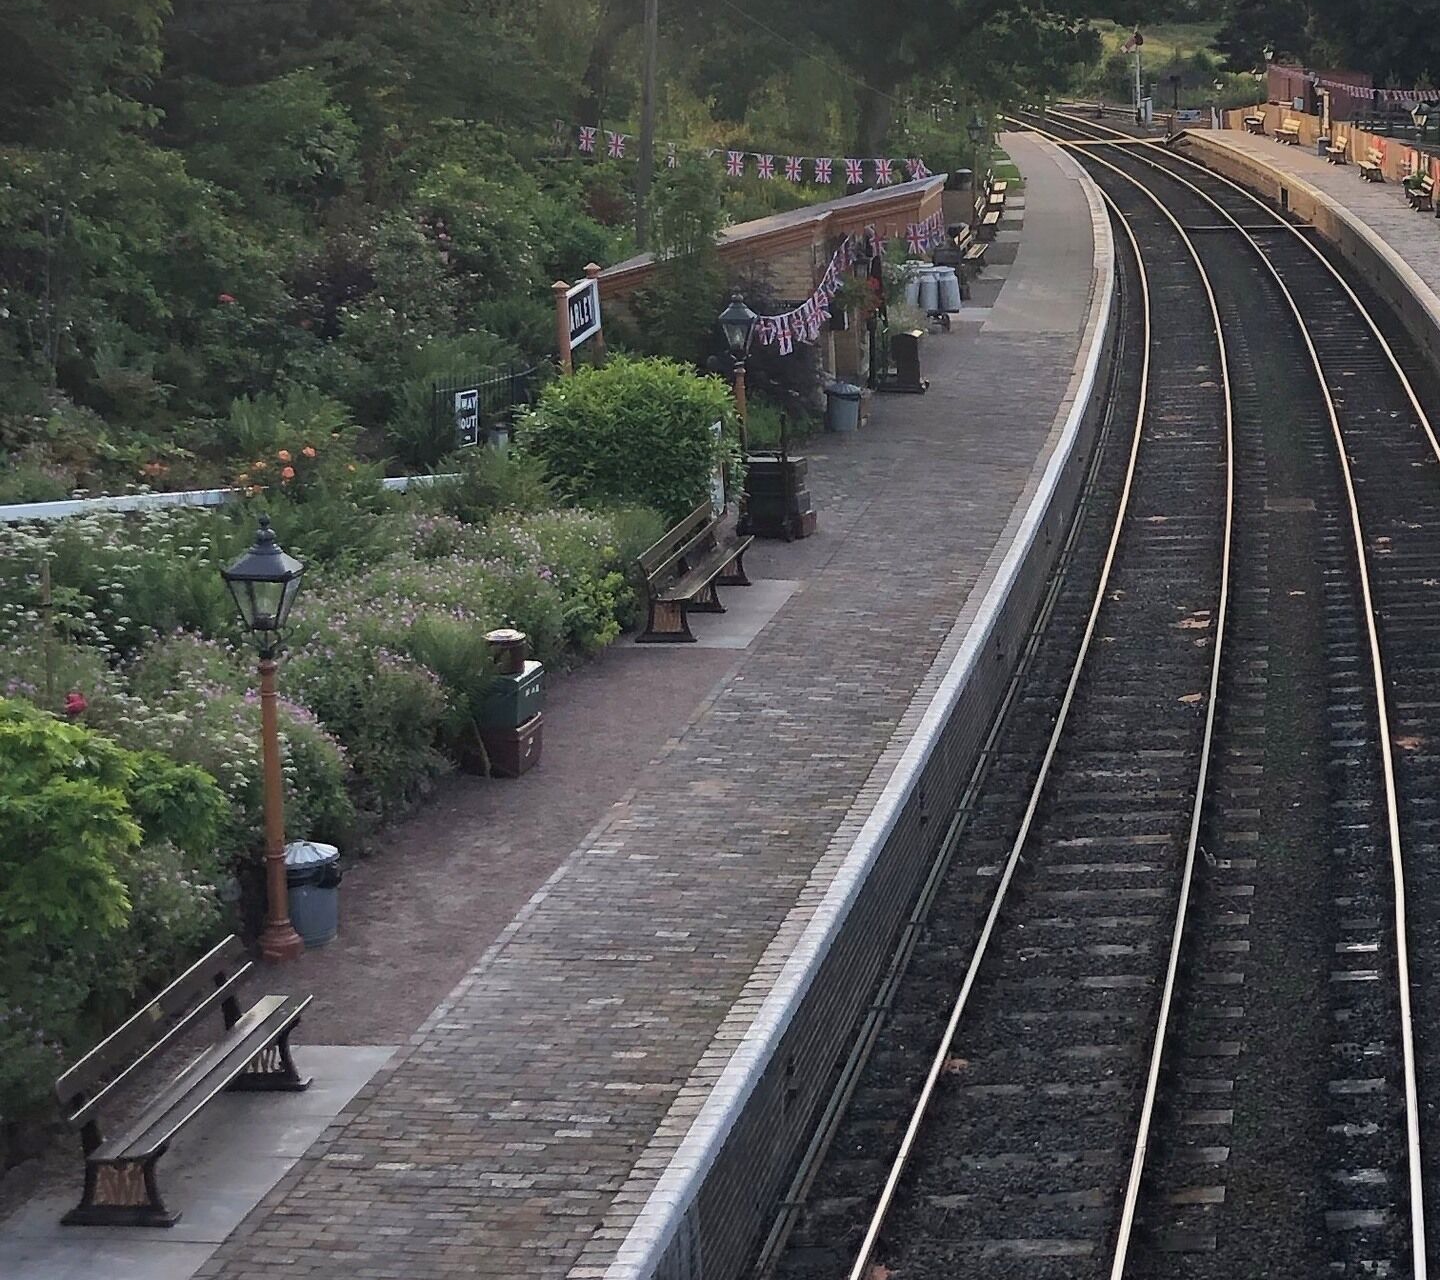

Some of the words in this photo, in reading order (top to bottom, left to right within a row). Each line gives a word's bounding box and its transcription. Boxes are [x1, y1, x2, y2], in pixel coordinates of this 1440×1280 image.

[570, 295, 592, 332] ARLEY
[461, 396, 476, 410] WAY
[460, 415, 476, 429] OUT
